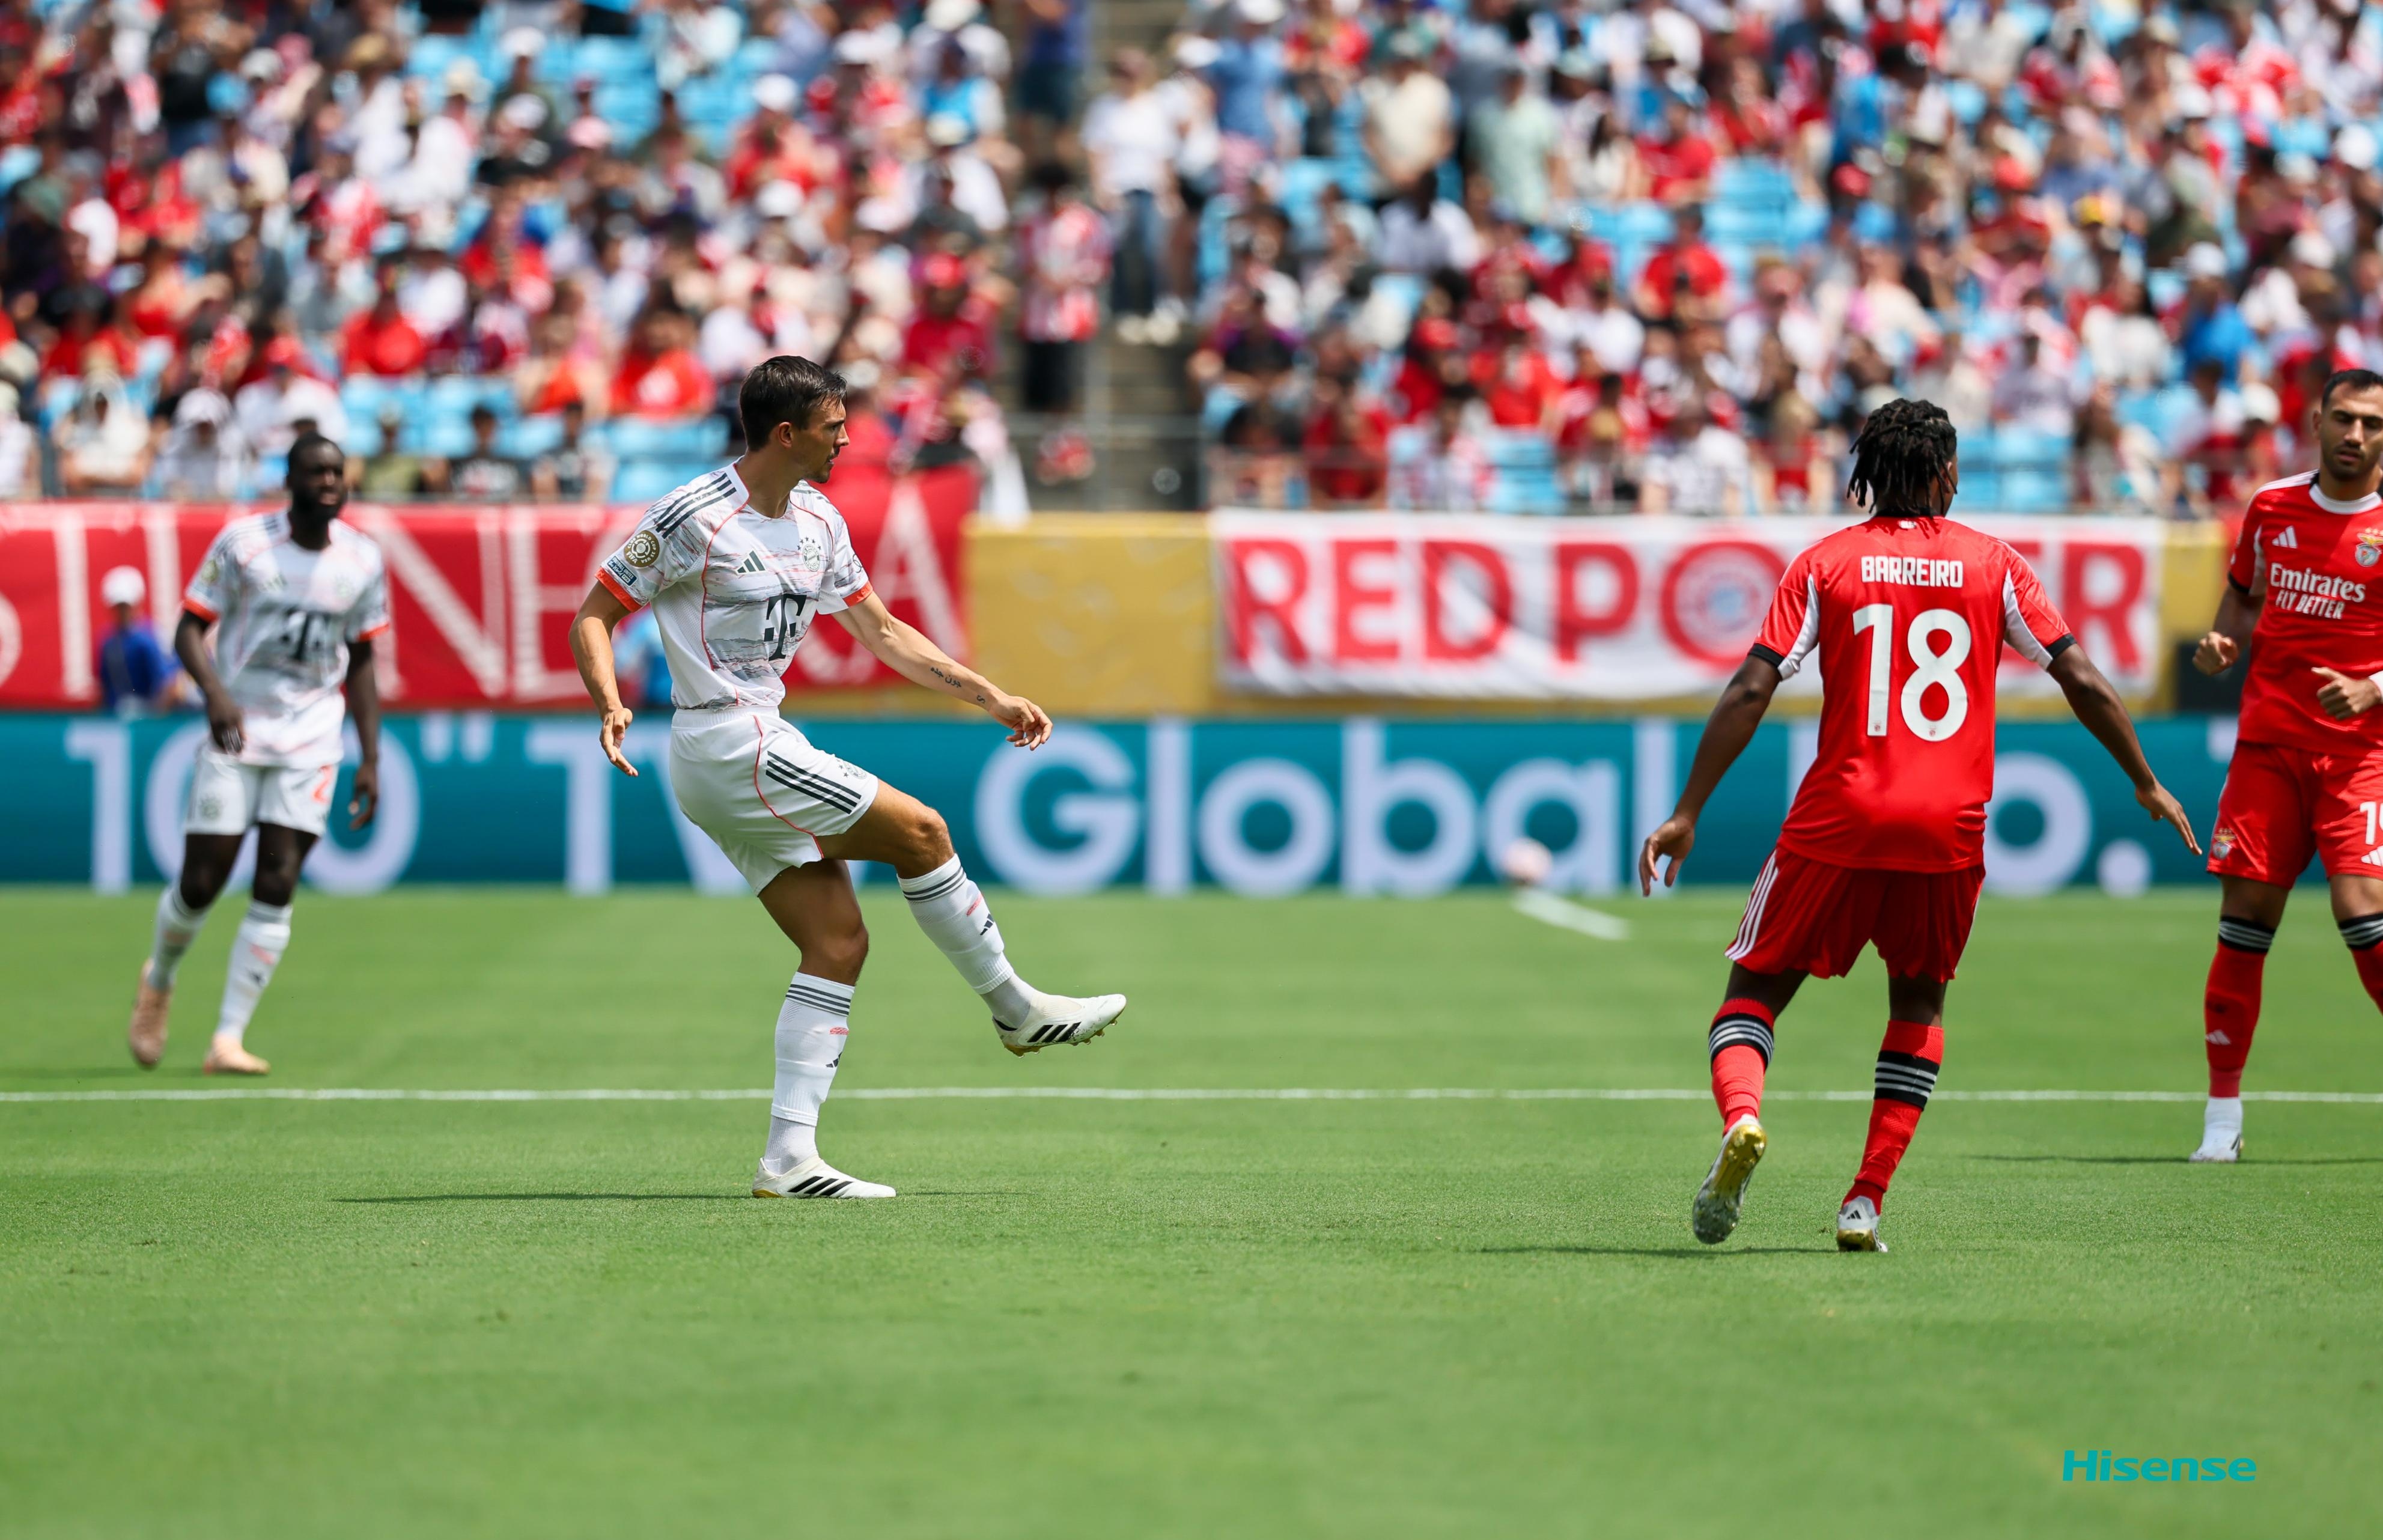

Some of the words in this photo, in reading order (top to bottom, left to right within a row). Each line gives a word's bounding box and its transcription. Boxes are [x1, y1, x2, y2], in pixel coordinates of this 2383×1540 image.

[626, 551, 638, 564] FIFA
[1861, 556, 1964, 588] BARREIRO
[1229, 537, 1513, 665] RED
[1551, 532, 2147, 673] POR
[2270, 562, 2366, 603] Emirates
[2275, 589, 2297, 610] FLY
[2295, 594, 2346, 619] BETTER
[764, 594, 807, 660] T
[1852, 603, 1971, 742] 18
[972, 713, 1678, 898] Global
[2359, 801, 2383, 845] 1
